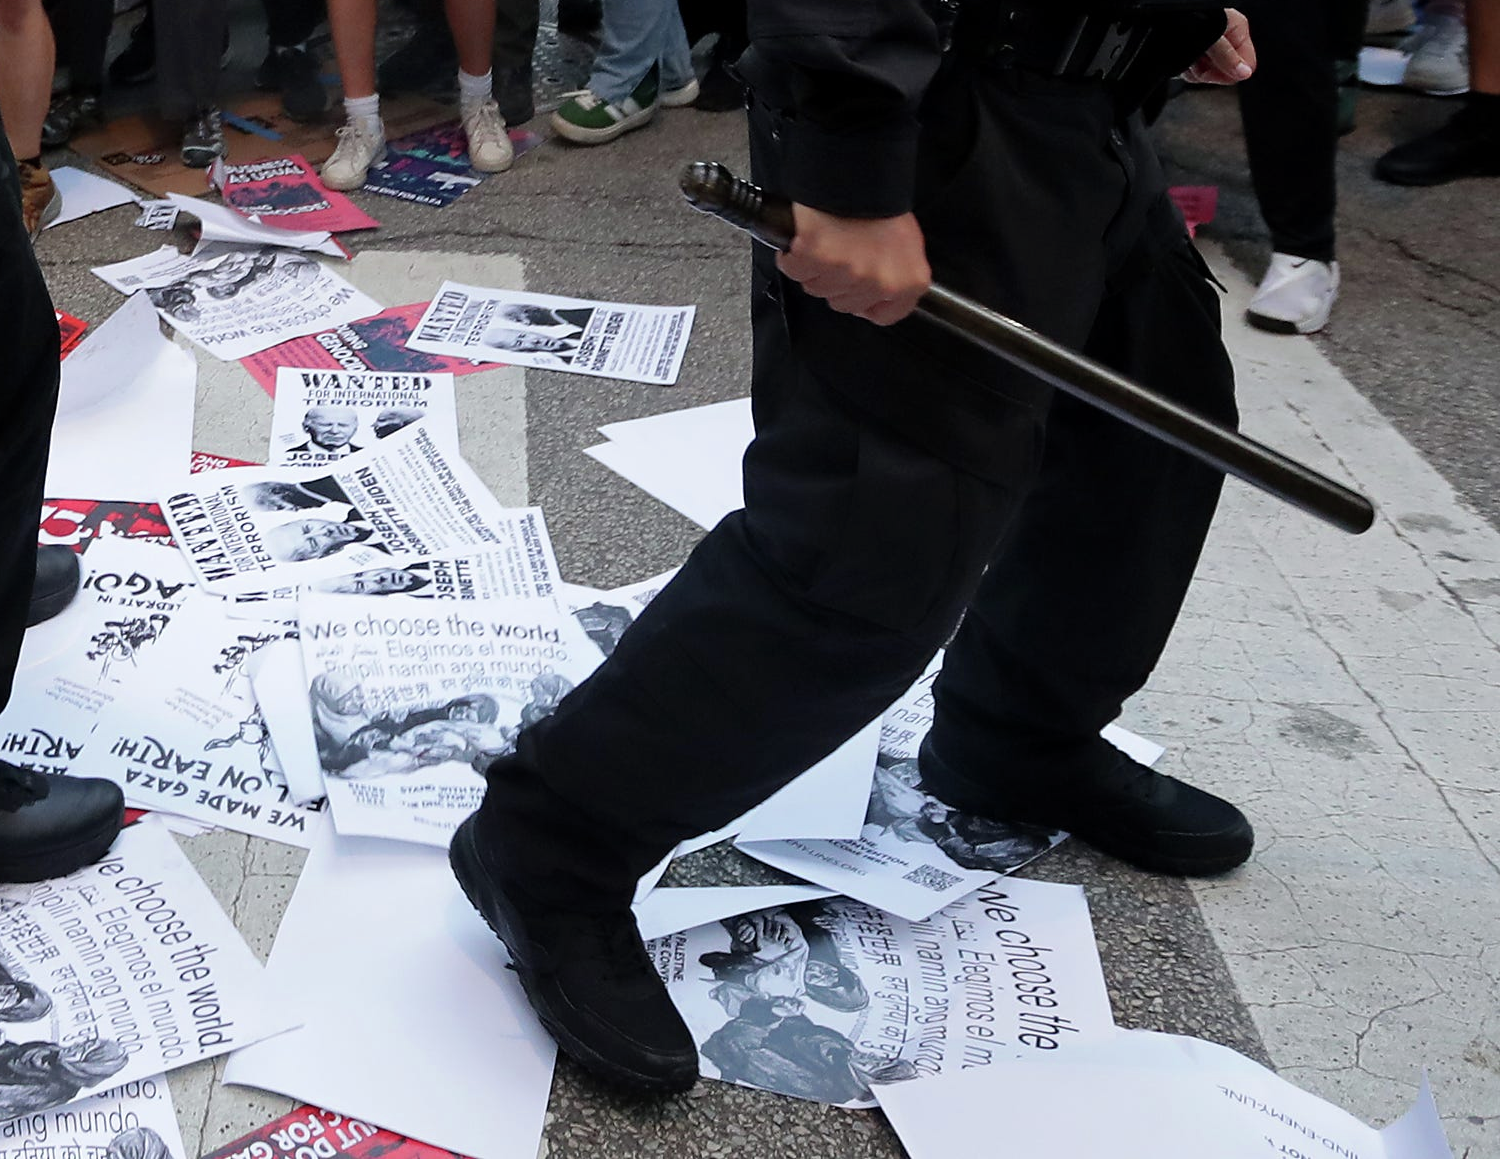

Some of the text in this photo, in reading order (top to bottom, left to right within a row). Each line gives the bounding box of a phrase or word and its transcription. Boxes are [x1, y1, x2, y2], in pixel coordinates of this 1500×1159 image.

[315, 332, 374, 375] GENOCID
[300, 373, 432, 391] WANTED
[308, 390, 422, 401] FOR INTERNATIONAL
[302, 398, 429, 408] TERRORISM
[417, 427, 441, 458] STOPPED
[353, 465, 390, 508] BIDEN
[436, 458, 457, 483] UNLESS
[440, 480, 462, 506] ARRIVE
[167, 490, 238, 583] WANTED
[202, 491, 253, 557] INTERNATIONAL
[220, 483, 278, 573] TERRORISM
[366, 509, 411, 557] JOSEPH
[384, 499, 431, 558] ROBINETTE
[96, 594, 113, 604] IN
[306, 613, 567, 646] We choose the world.
[386, 640, 573, 664] Elegimos el mundo.
[389, 662, 446, 678] namin
[450, 662, 486, 680] ang
[0, 728, 84, 761] ARTH!
[108, 735, 215, 781] EARTH!
[124, 767, 189, 798] GAZA
[218, 765, 262, 794] ON
[196, 790, 262, 818] MADE
[114, 875, 193, 947] choose
[59, 916, 106, 969] namin
[169, 942, 219, 983] the
[977, 880, 1081, 1050] We choose the
[89, 964, 123, 1001] ang
[95, 904, 186, 1066] Elegimos el mundo.
[953, 947, 1007, 1047] Elegimos el
[105, 996, 151, 1055] mundo
[185, 981, 235, 1055] world.
[913, 938, 949, 1077] namin ang mund
[2, 1117, 48, 1142] ang
[270, 1114, 325, 1152] FOR
